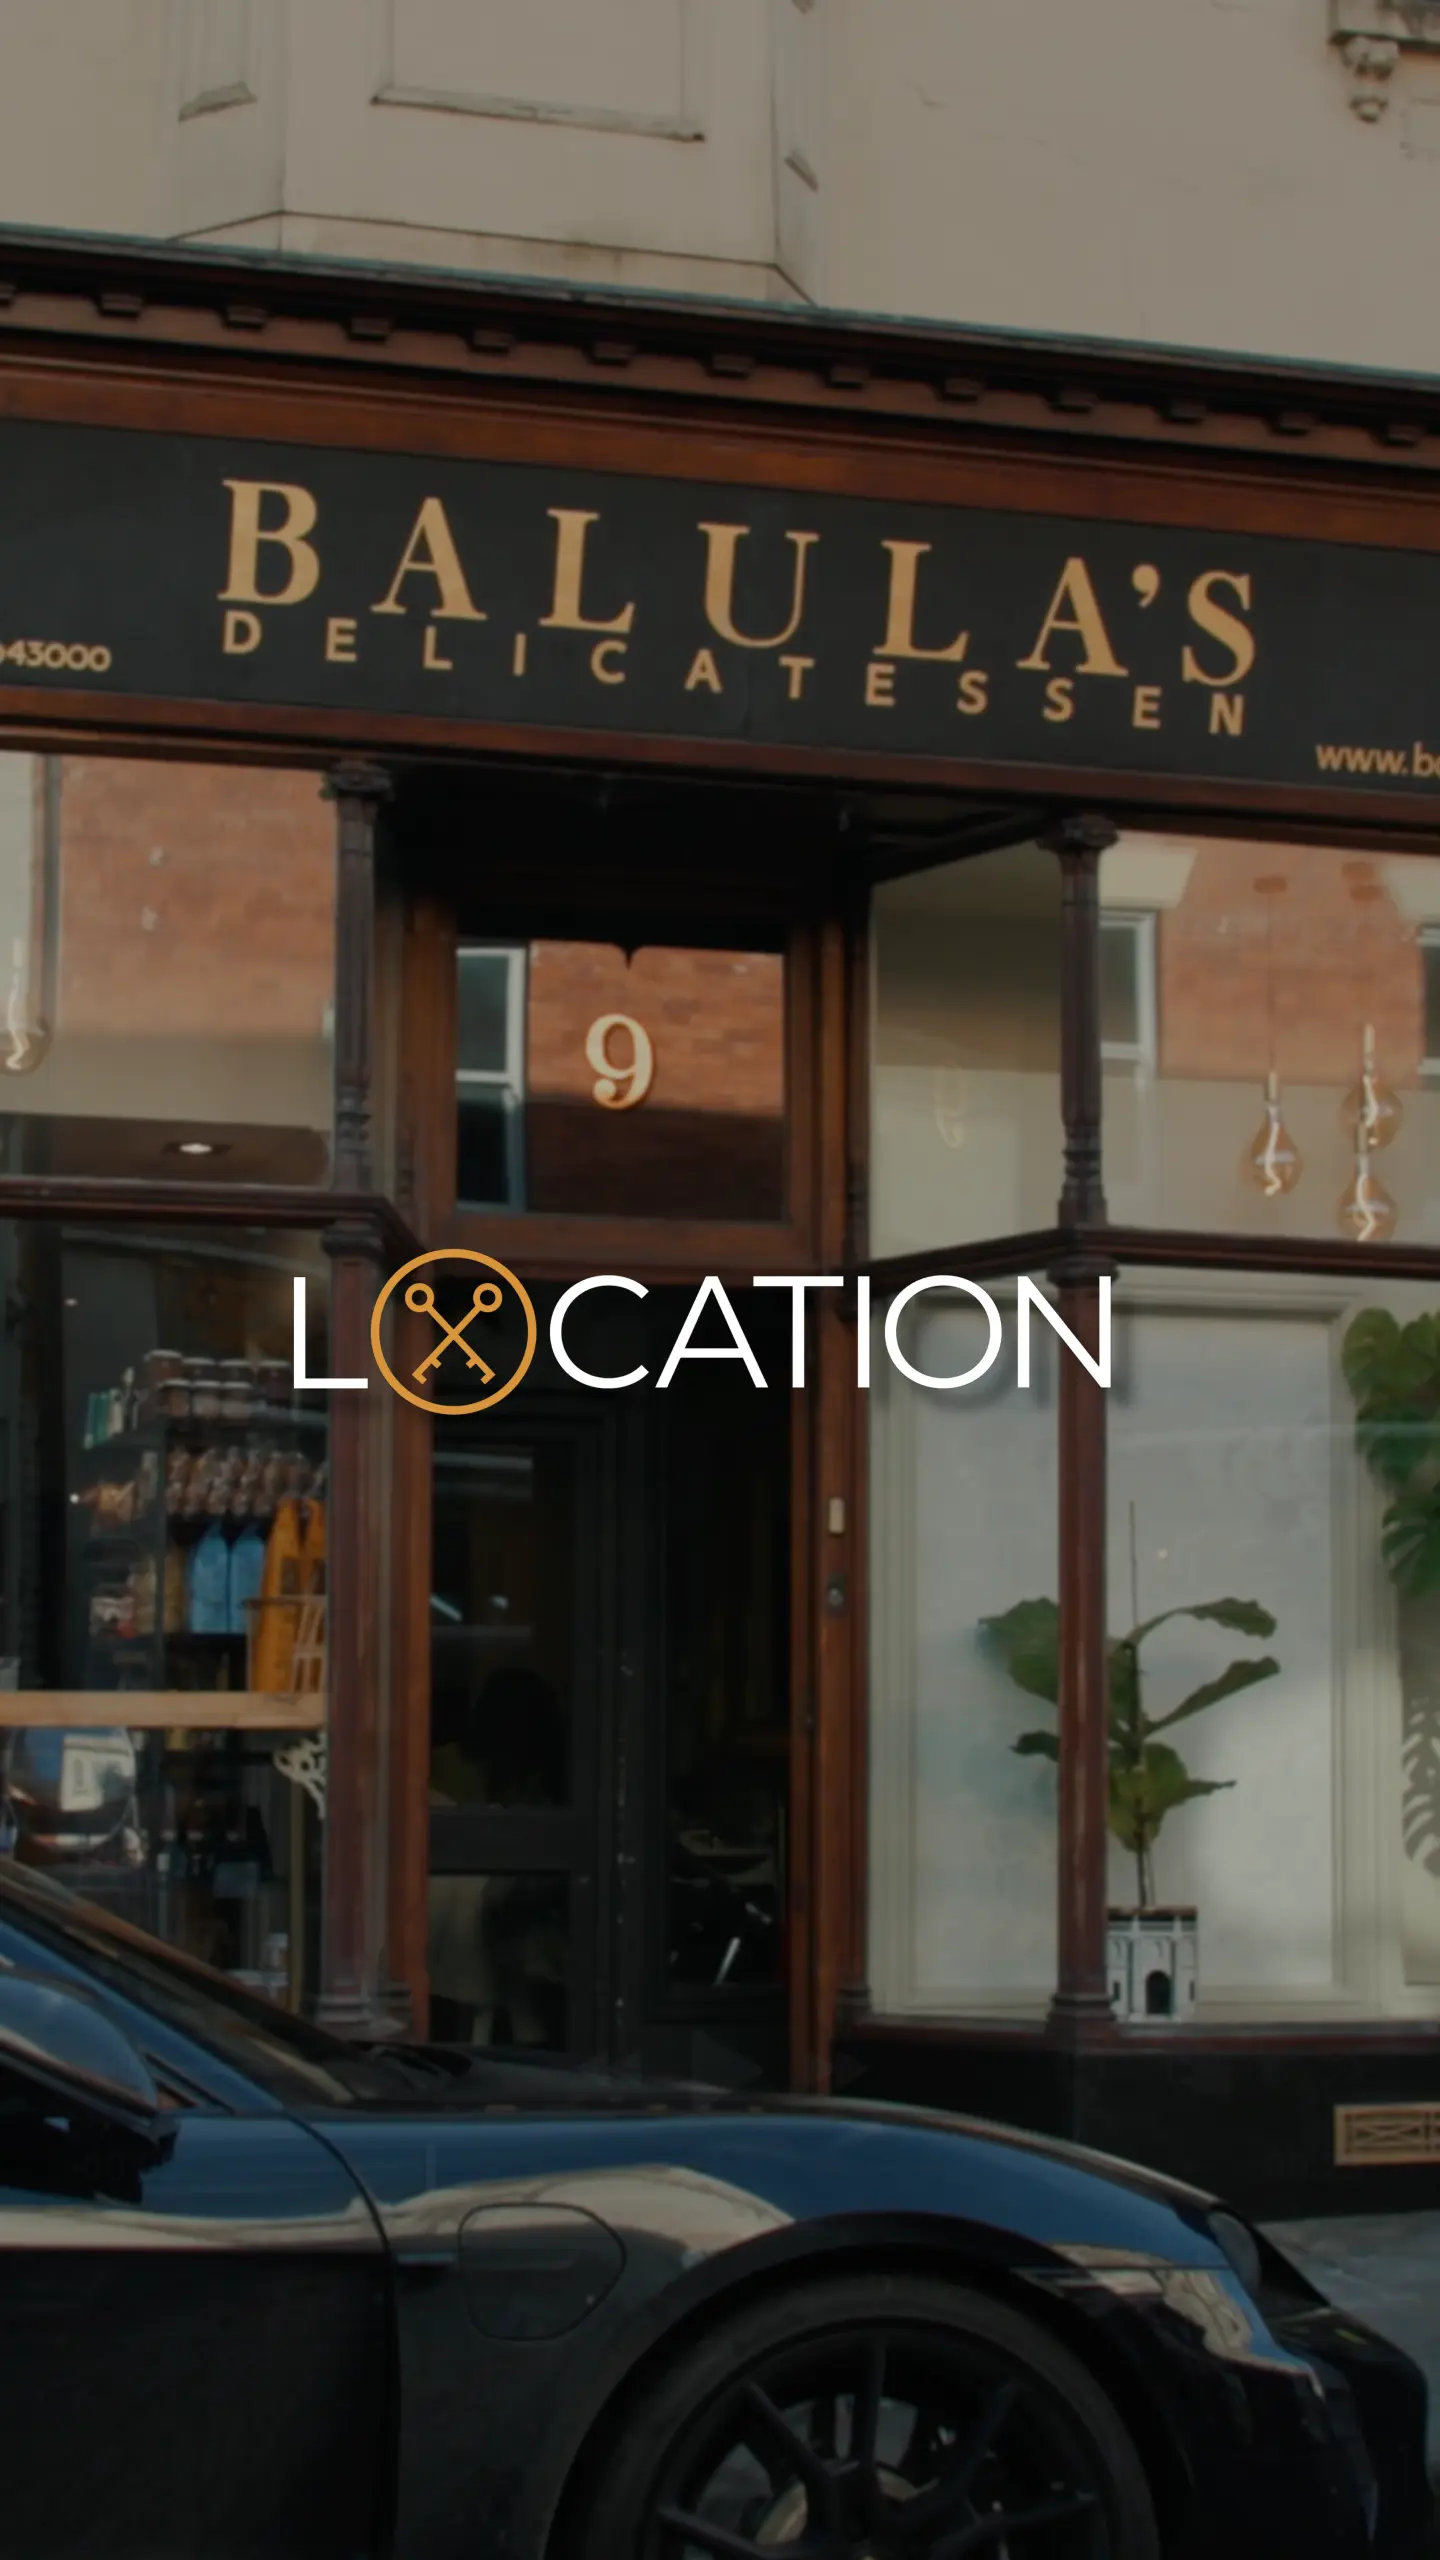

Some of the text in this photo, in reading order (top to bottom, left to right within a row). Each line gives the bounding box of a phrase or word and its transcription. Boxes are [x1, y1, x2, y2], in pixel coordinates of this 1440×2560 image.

[218, 479, 1255, 686] BALULA'S
[0, 639, 111, 671] 43000
[223, 609, 1244, 736] DELICATESSEN
[586, 1013, 653, 1109] 9
